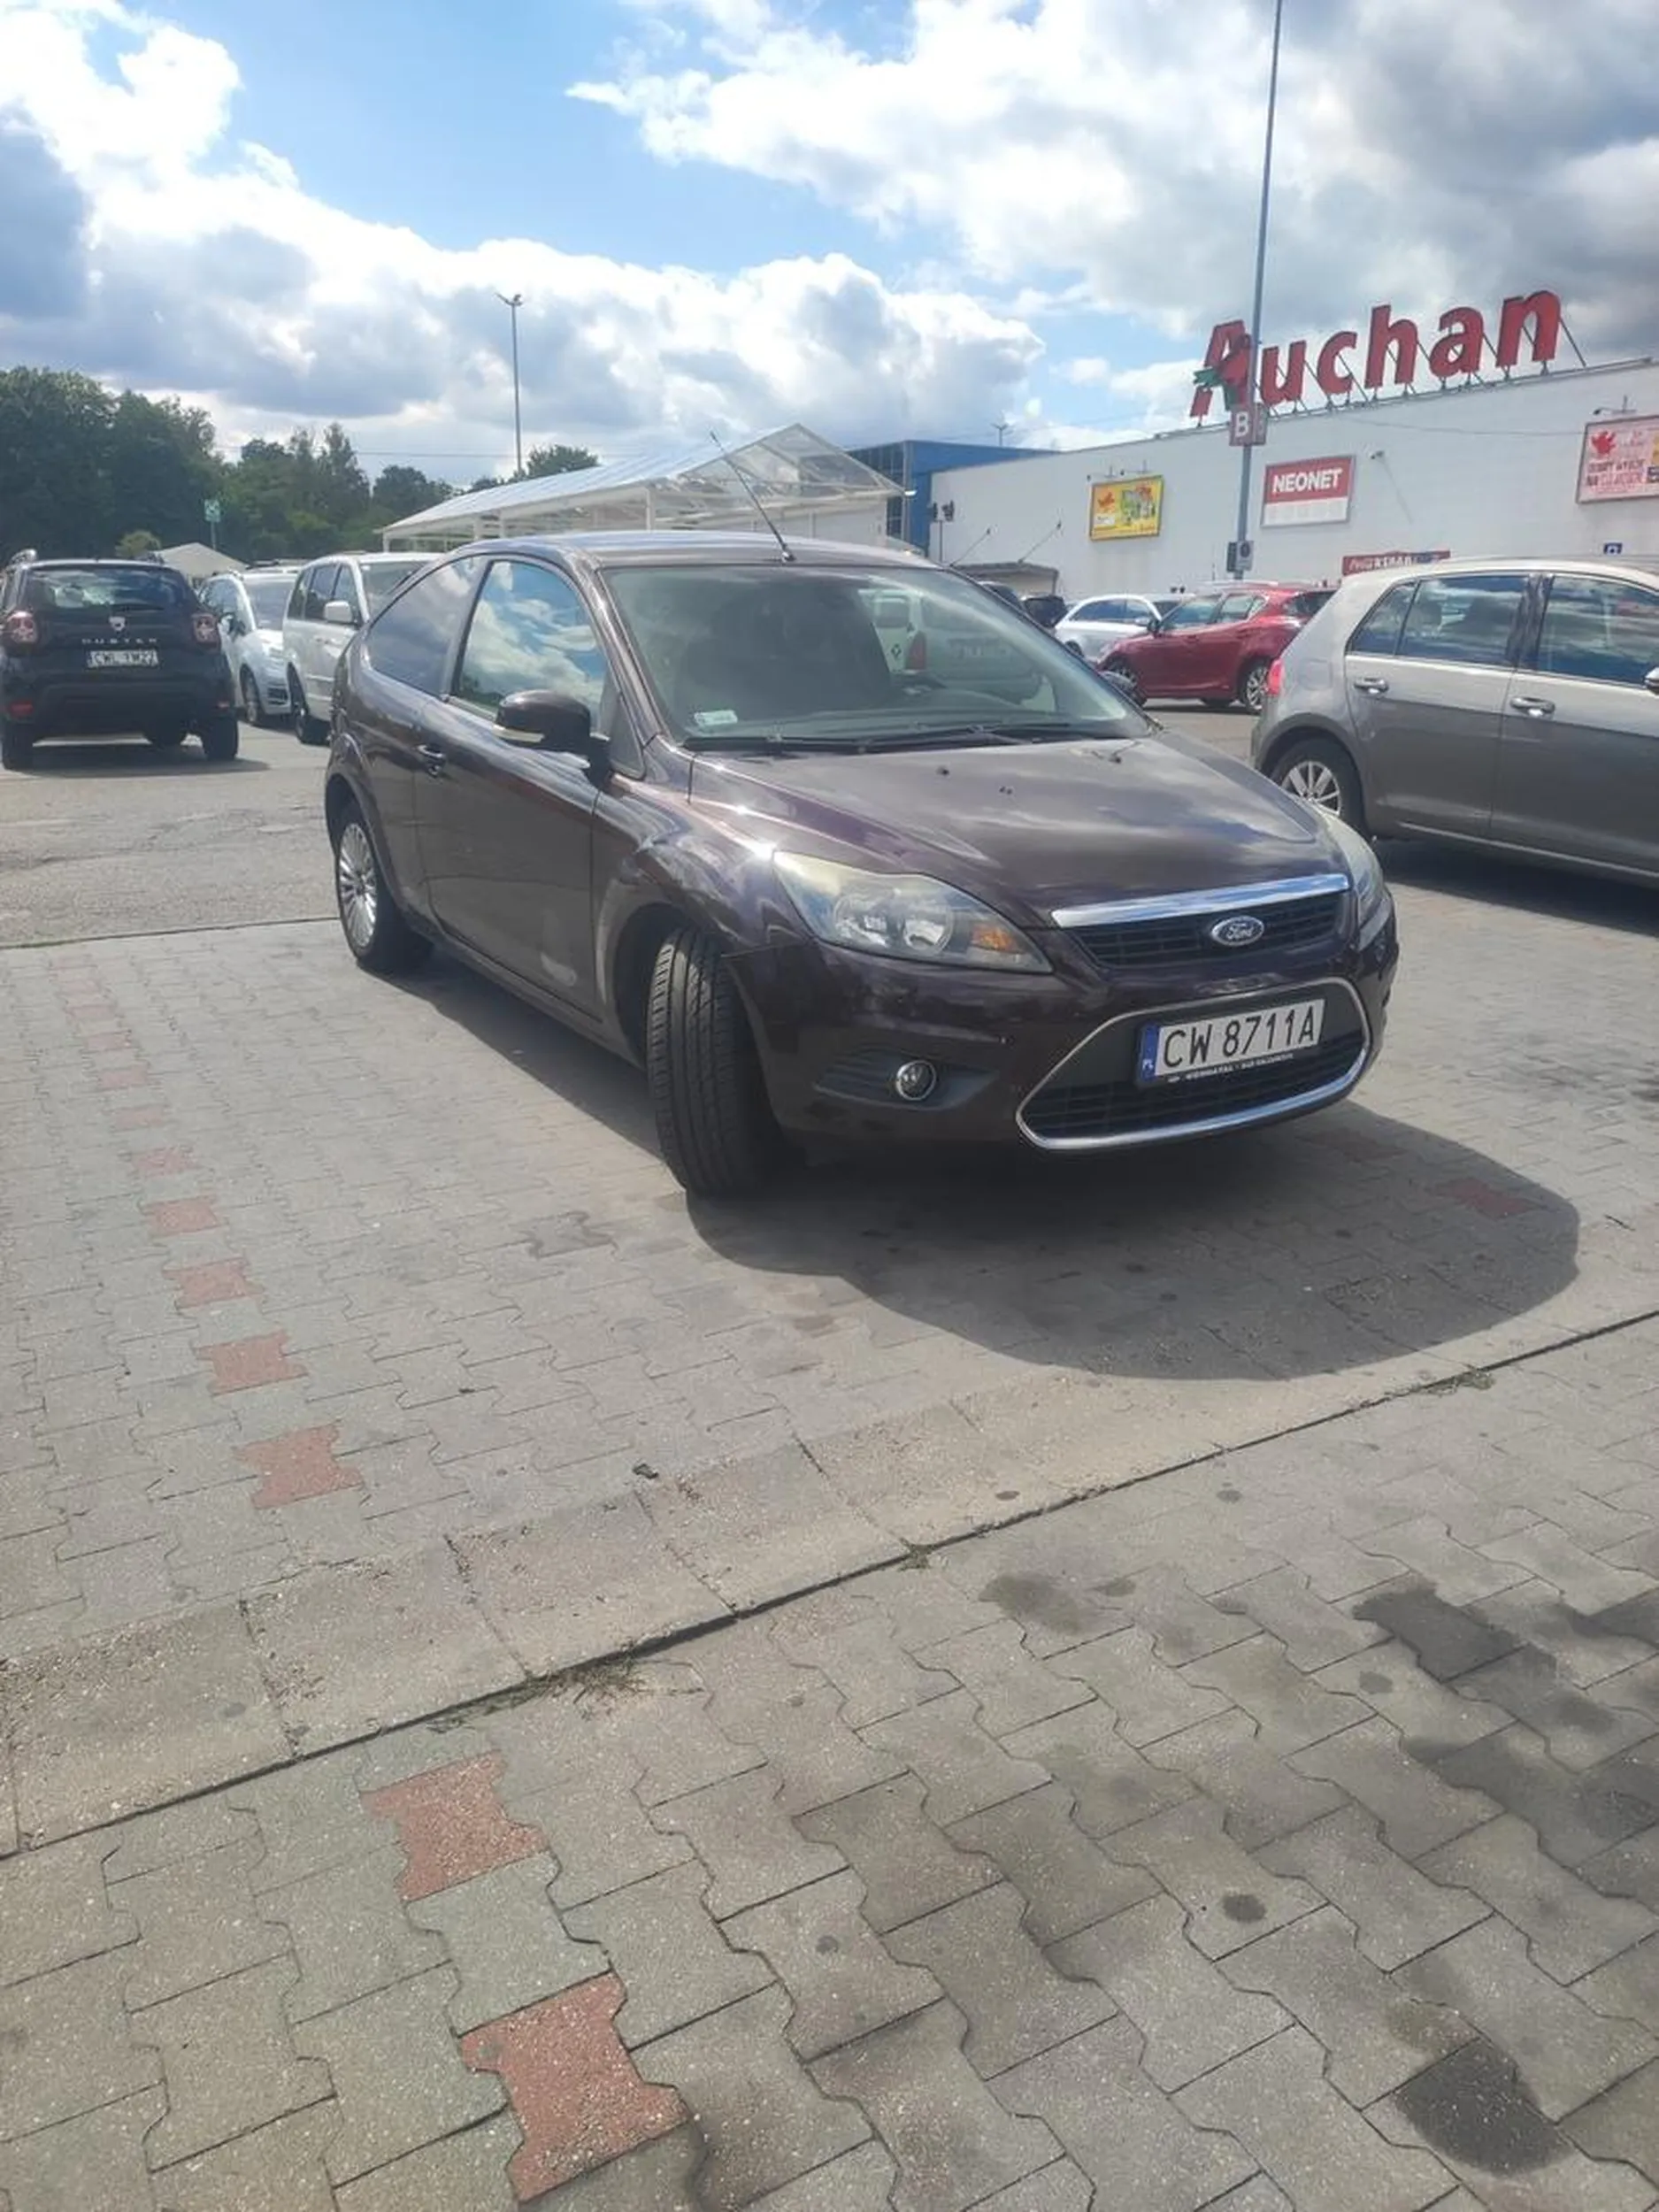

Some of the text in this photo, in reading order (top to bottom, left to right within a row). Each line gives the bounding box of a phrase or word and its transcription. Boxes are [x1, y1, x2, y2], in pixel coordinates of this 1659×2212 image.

[1190, 289, 1562, 418] Auchan
[1234, 411, 1250, 438] B
[1271, 467, 1344, 497] NEONET
[1164, 1004, 1316, 1068] CW 8711A
